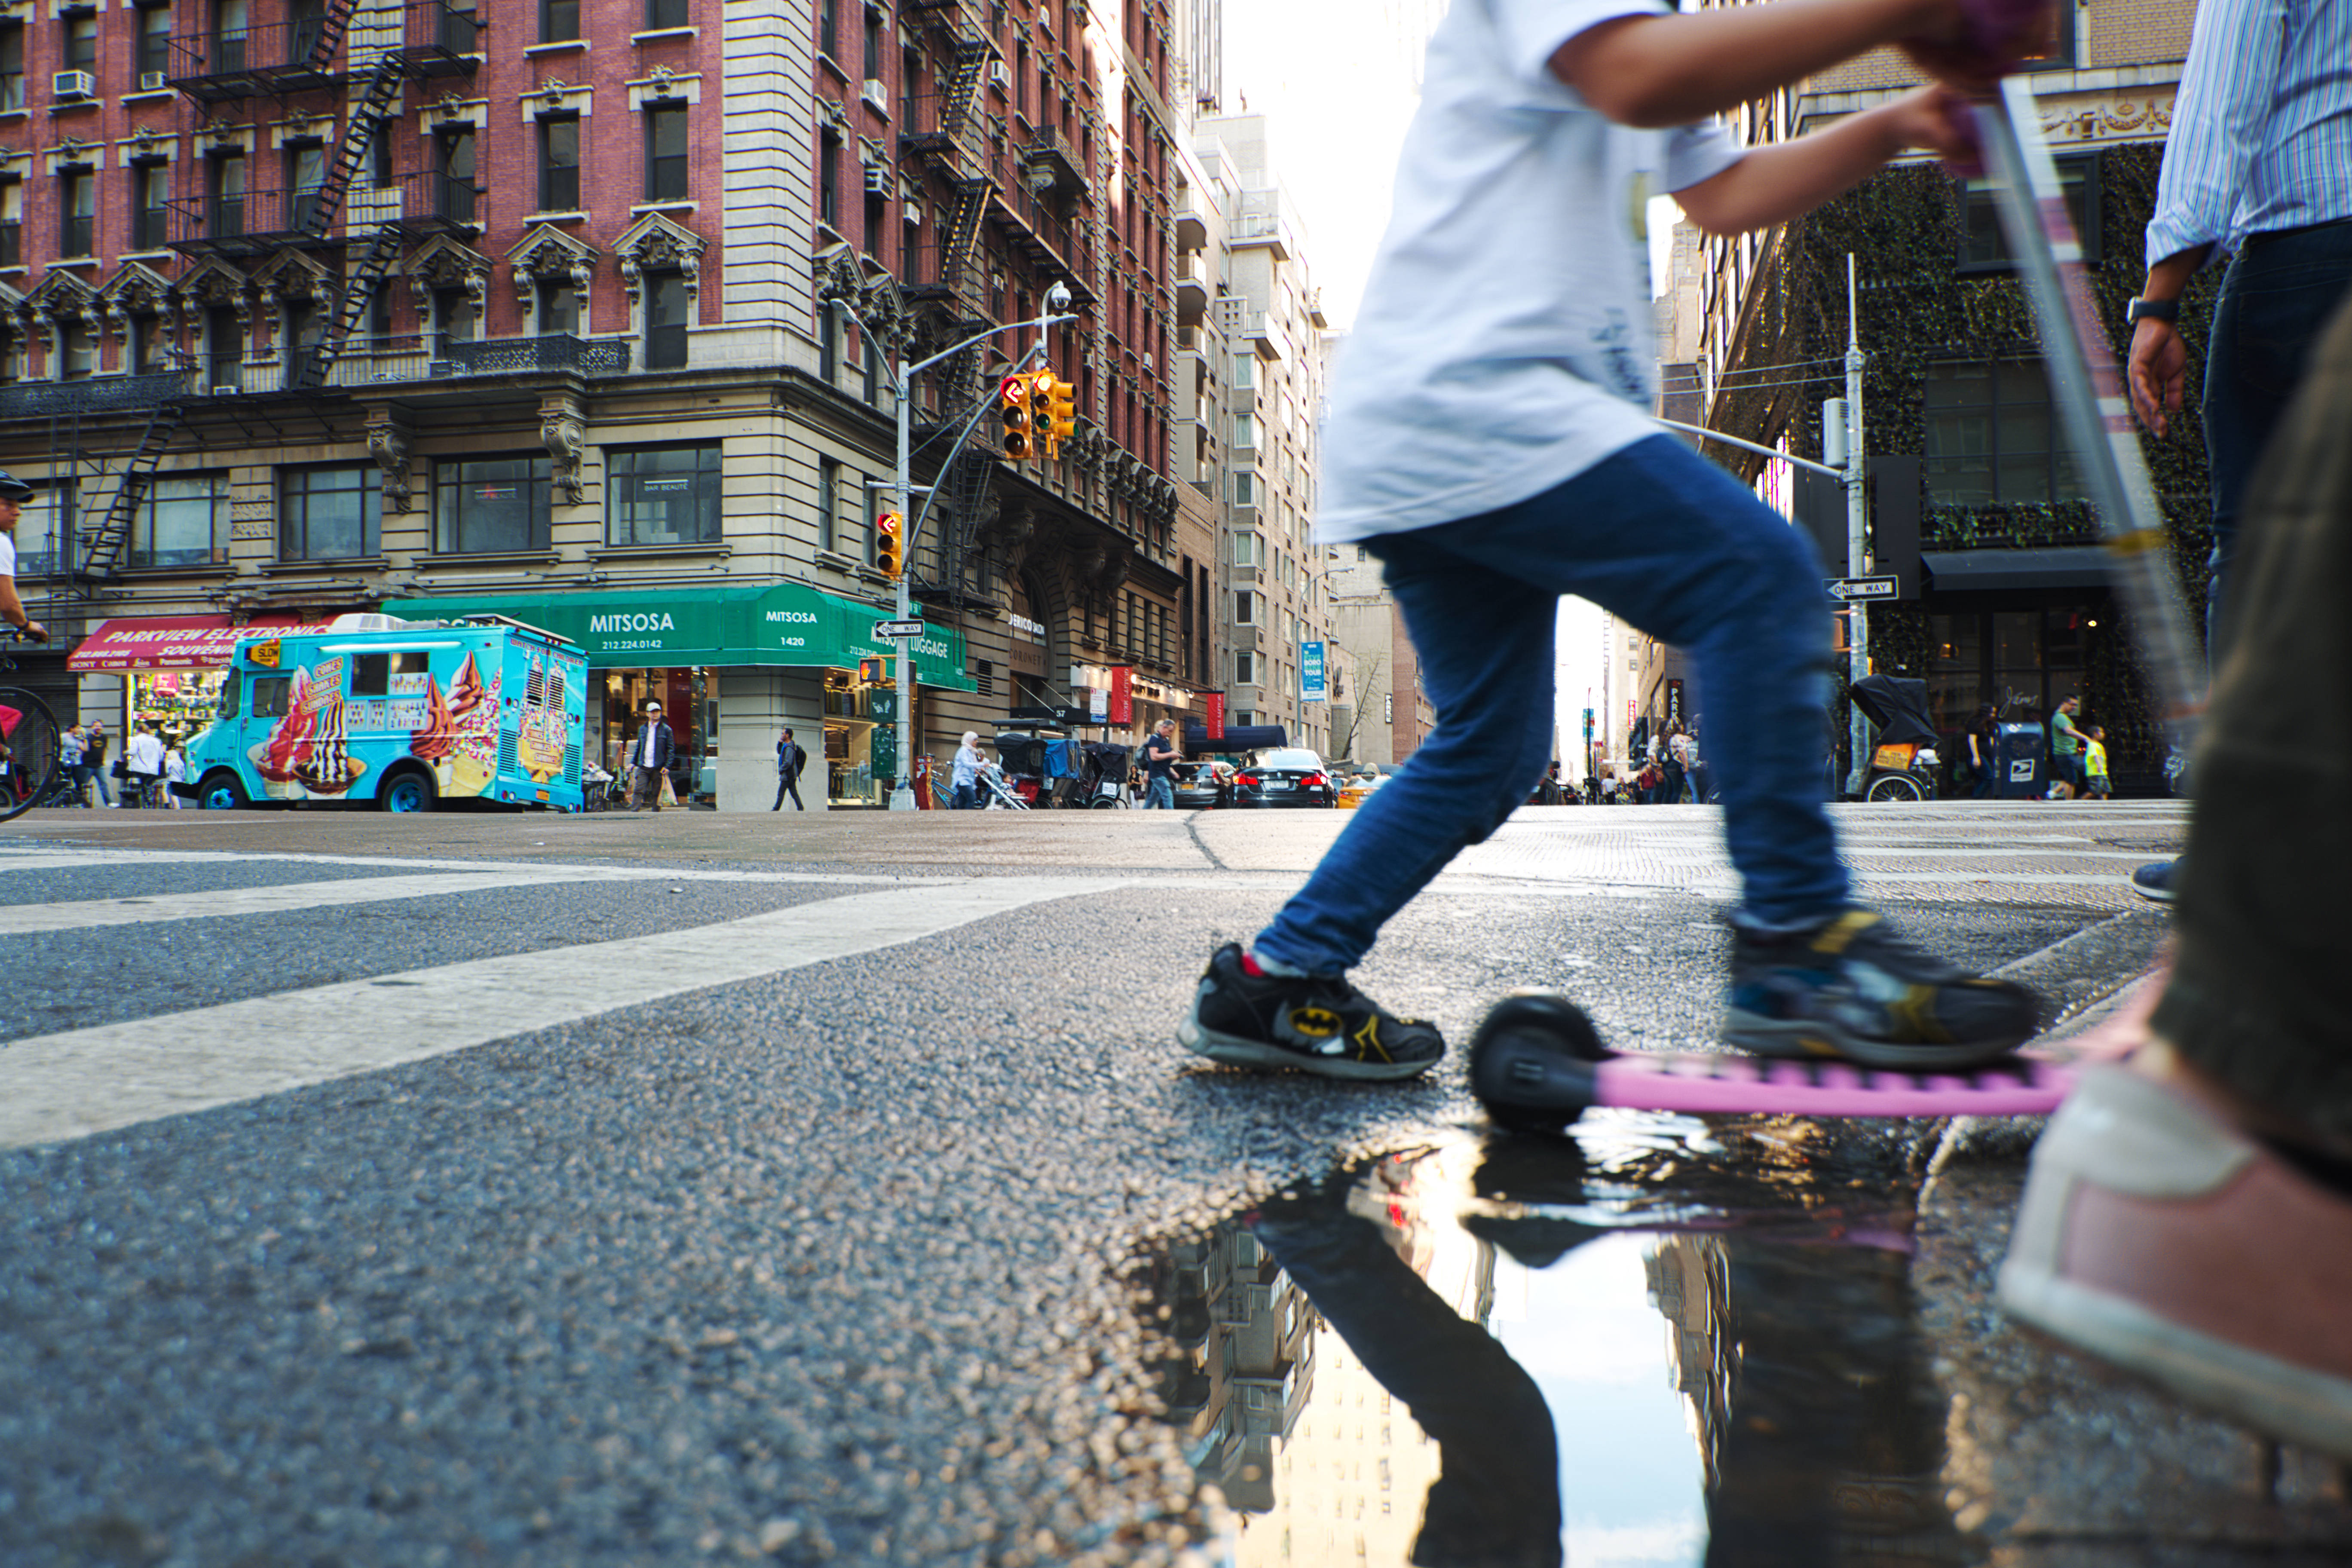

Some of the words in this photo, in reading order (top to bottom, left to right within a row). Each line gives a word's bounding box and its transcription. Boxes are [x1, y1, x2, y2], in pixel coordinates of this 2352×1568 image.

[1834, 585, 1855, 594] ONE
[1864, 583, 1887, 593] WAY
[590, 612, 675, 632] MITSOSA
[766, 610, 818, 623] MITSOSA
[103, 628, 210, 643] PARKVIEW
[203, 625, 328, 640] ELECTRONIC
[780, 637, 805, 646] 1420
[258, 648, 279, 657] SLOW
[510, 638, 535, 652] WATCH
[537, 646, 551, 656] FOR
[553, 651, 584, 667] CHILDREN
[602, 640, 662, 649] 212.224.0142
[911, 637, 948, 658] LUGGAGE
[159, 658, 193, 666] Panasonic
[1009, 648, 1041, 666] CORONET
[315, 658, 343, 678] CONES
[308, 674, 341, 696] SHAKES
[302, 689, 340, 714] SUNDAES
[1056, 710, 1066, 718] 57
